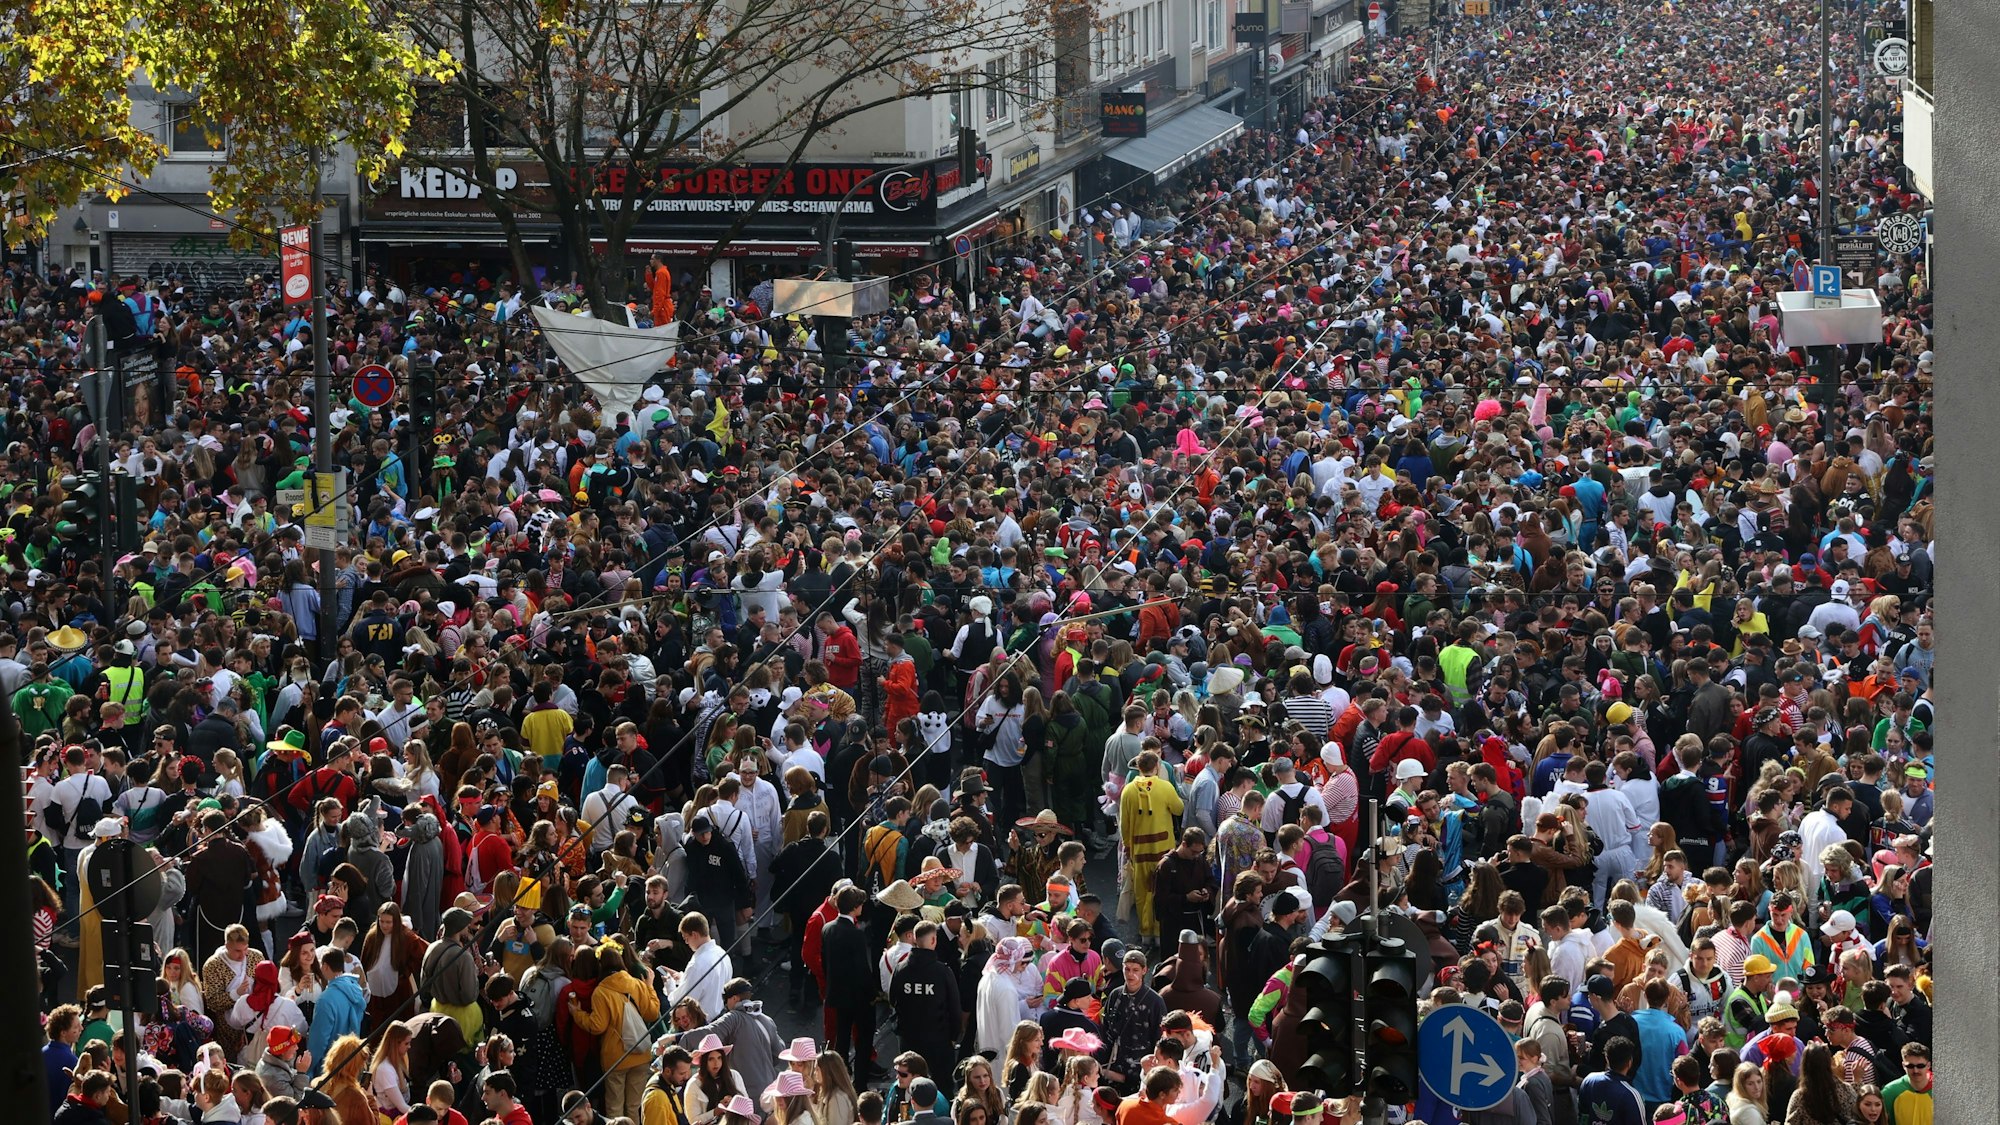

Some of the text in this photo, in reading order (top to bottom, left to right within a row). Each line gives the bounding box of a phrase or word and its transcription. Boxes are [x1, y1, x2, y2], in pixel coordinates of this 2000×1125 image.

[1236, 23, 1264, 32] duma
[660, 168, 795, 195] BURGER
[806, 168, 875, 195] ONE
[1883, 215, 1918, 230] FRISEUR
[281, 228, 309, 247] REWE
[1892, 226, 1908, 240] K&B
[1883, 237, 1918, 252] 9383320
[1819, 270, 1834, 292] P
[368, 624, 393, 641] FBI
[1708, 777, 1719, 791] 9
[708, 854, 721, 867] SEK
[904, 983, 934, 995] SEK
